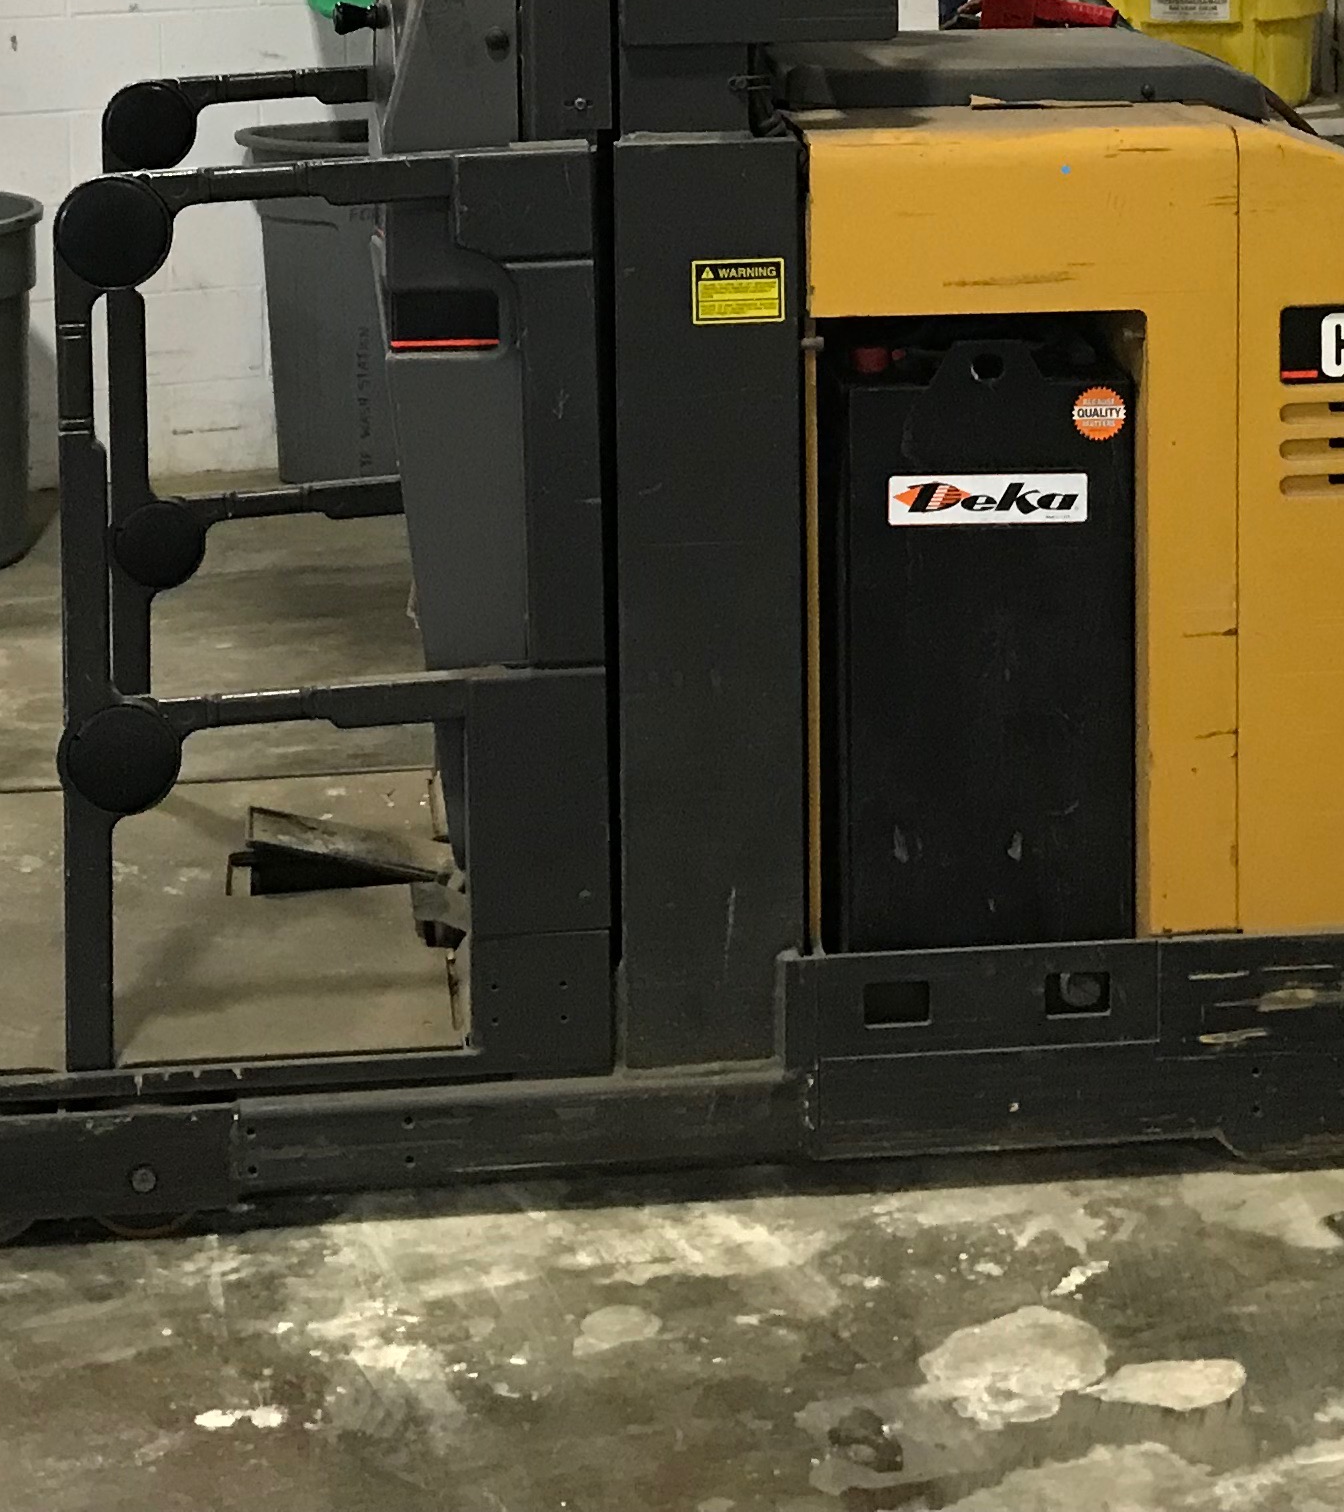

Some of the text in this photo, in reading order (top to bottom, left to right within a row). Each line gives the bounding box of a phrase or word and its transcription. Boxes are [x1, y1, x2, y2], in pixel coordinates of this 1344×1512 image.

[717, 266, 777, 278] WARNING
[1076, 407, 1121, 418] QUALITY
[907, 480, 1079, 515] Deka
